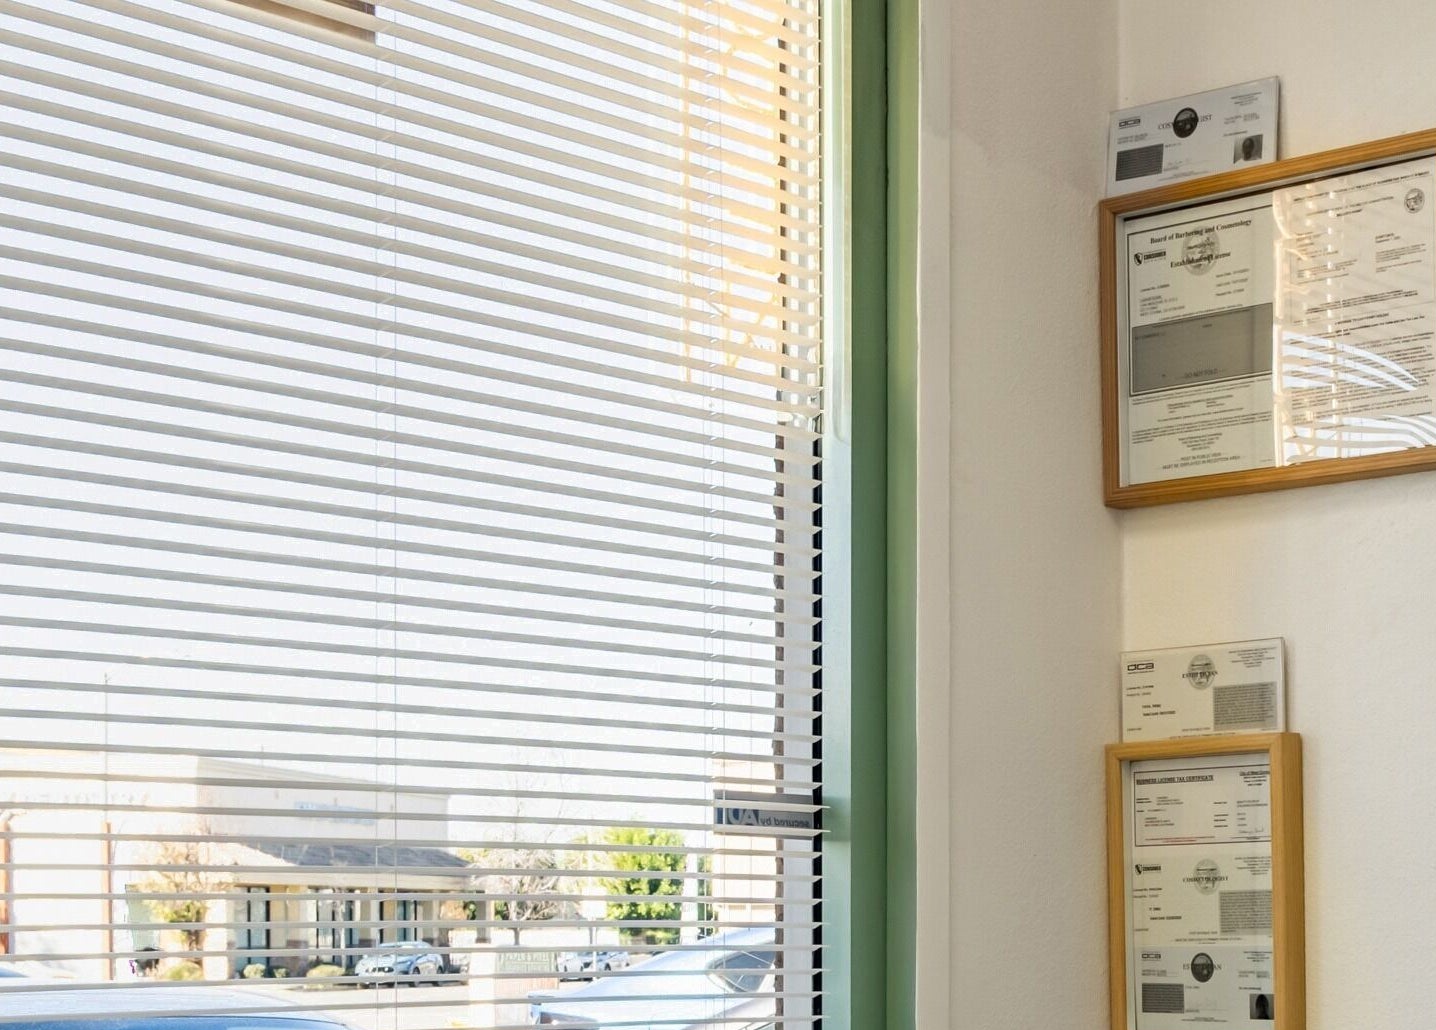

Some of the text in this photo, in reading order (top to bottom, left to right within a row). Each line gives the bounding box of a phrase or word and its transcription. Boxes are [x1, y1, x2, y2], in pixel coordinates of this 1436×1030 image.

[1150, 236, 1167, 245] Board
[1175, 229, 1203, 239] Barbering
[1205, 225, 1215, 233] and
[1216, 219, 1252, 231] Cosmetology
